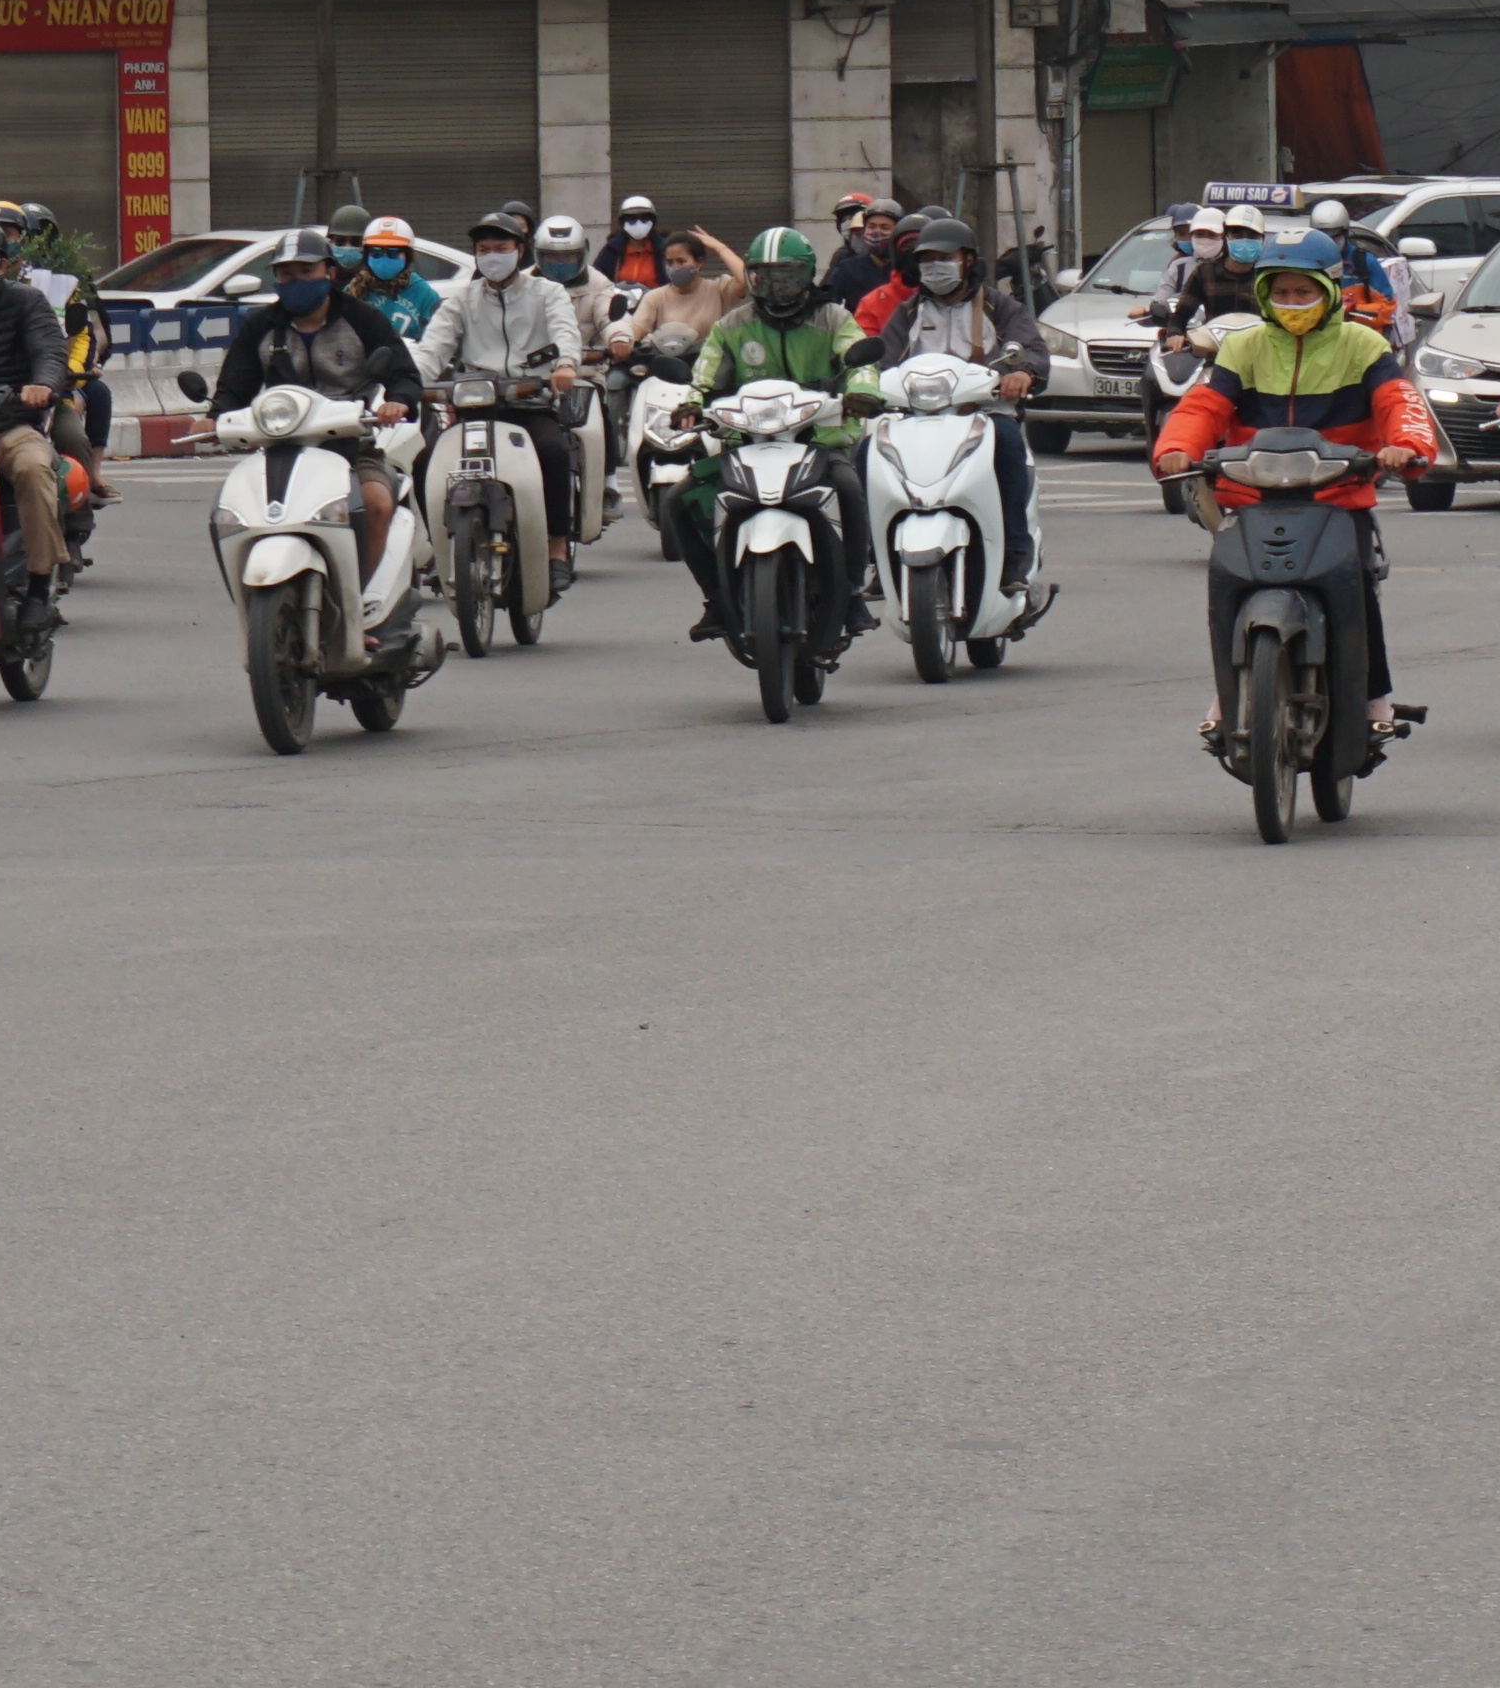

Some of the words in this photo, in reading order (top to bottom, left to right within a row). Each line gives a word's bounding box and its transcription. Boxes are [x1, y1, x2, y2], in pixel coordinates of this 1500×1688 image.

[134, 78, 156, 91] ANH
[125, 103, 167, 134] VÀNG
[127, 150, 166, 179] 9999
[1210, 186, 1225, 200] HA
[1226, 186, 1245, 201] NOI
[1247, 186, 1269, 201] SAO
[124, 194, 170, 217] TRANG
